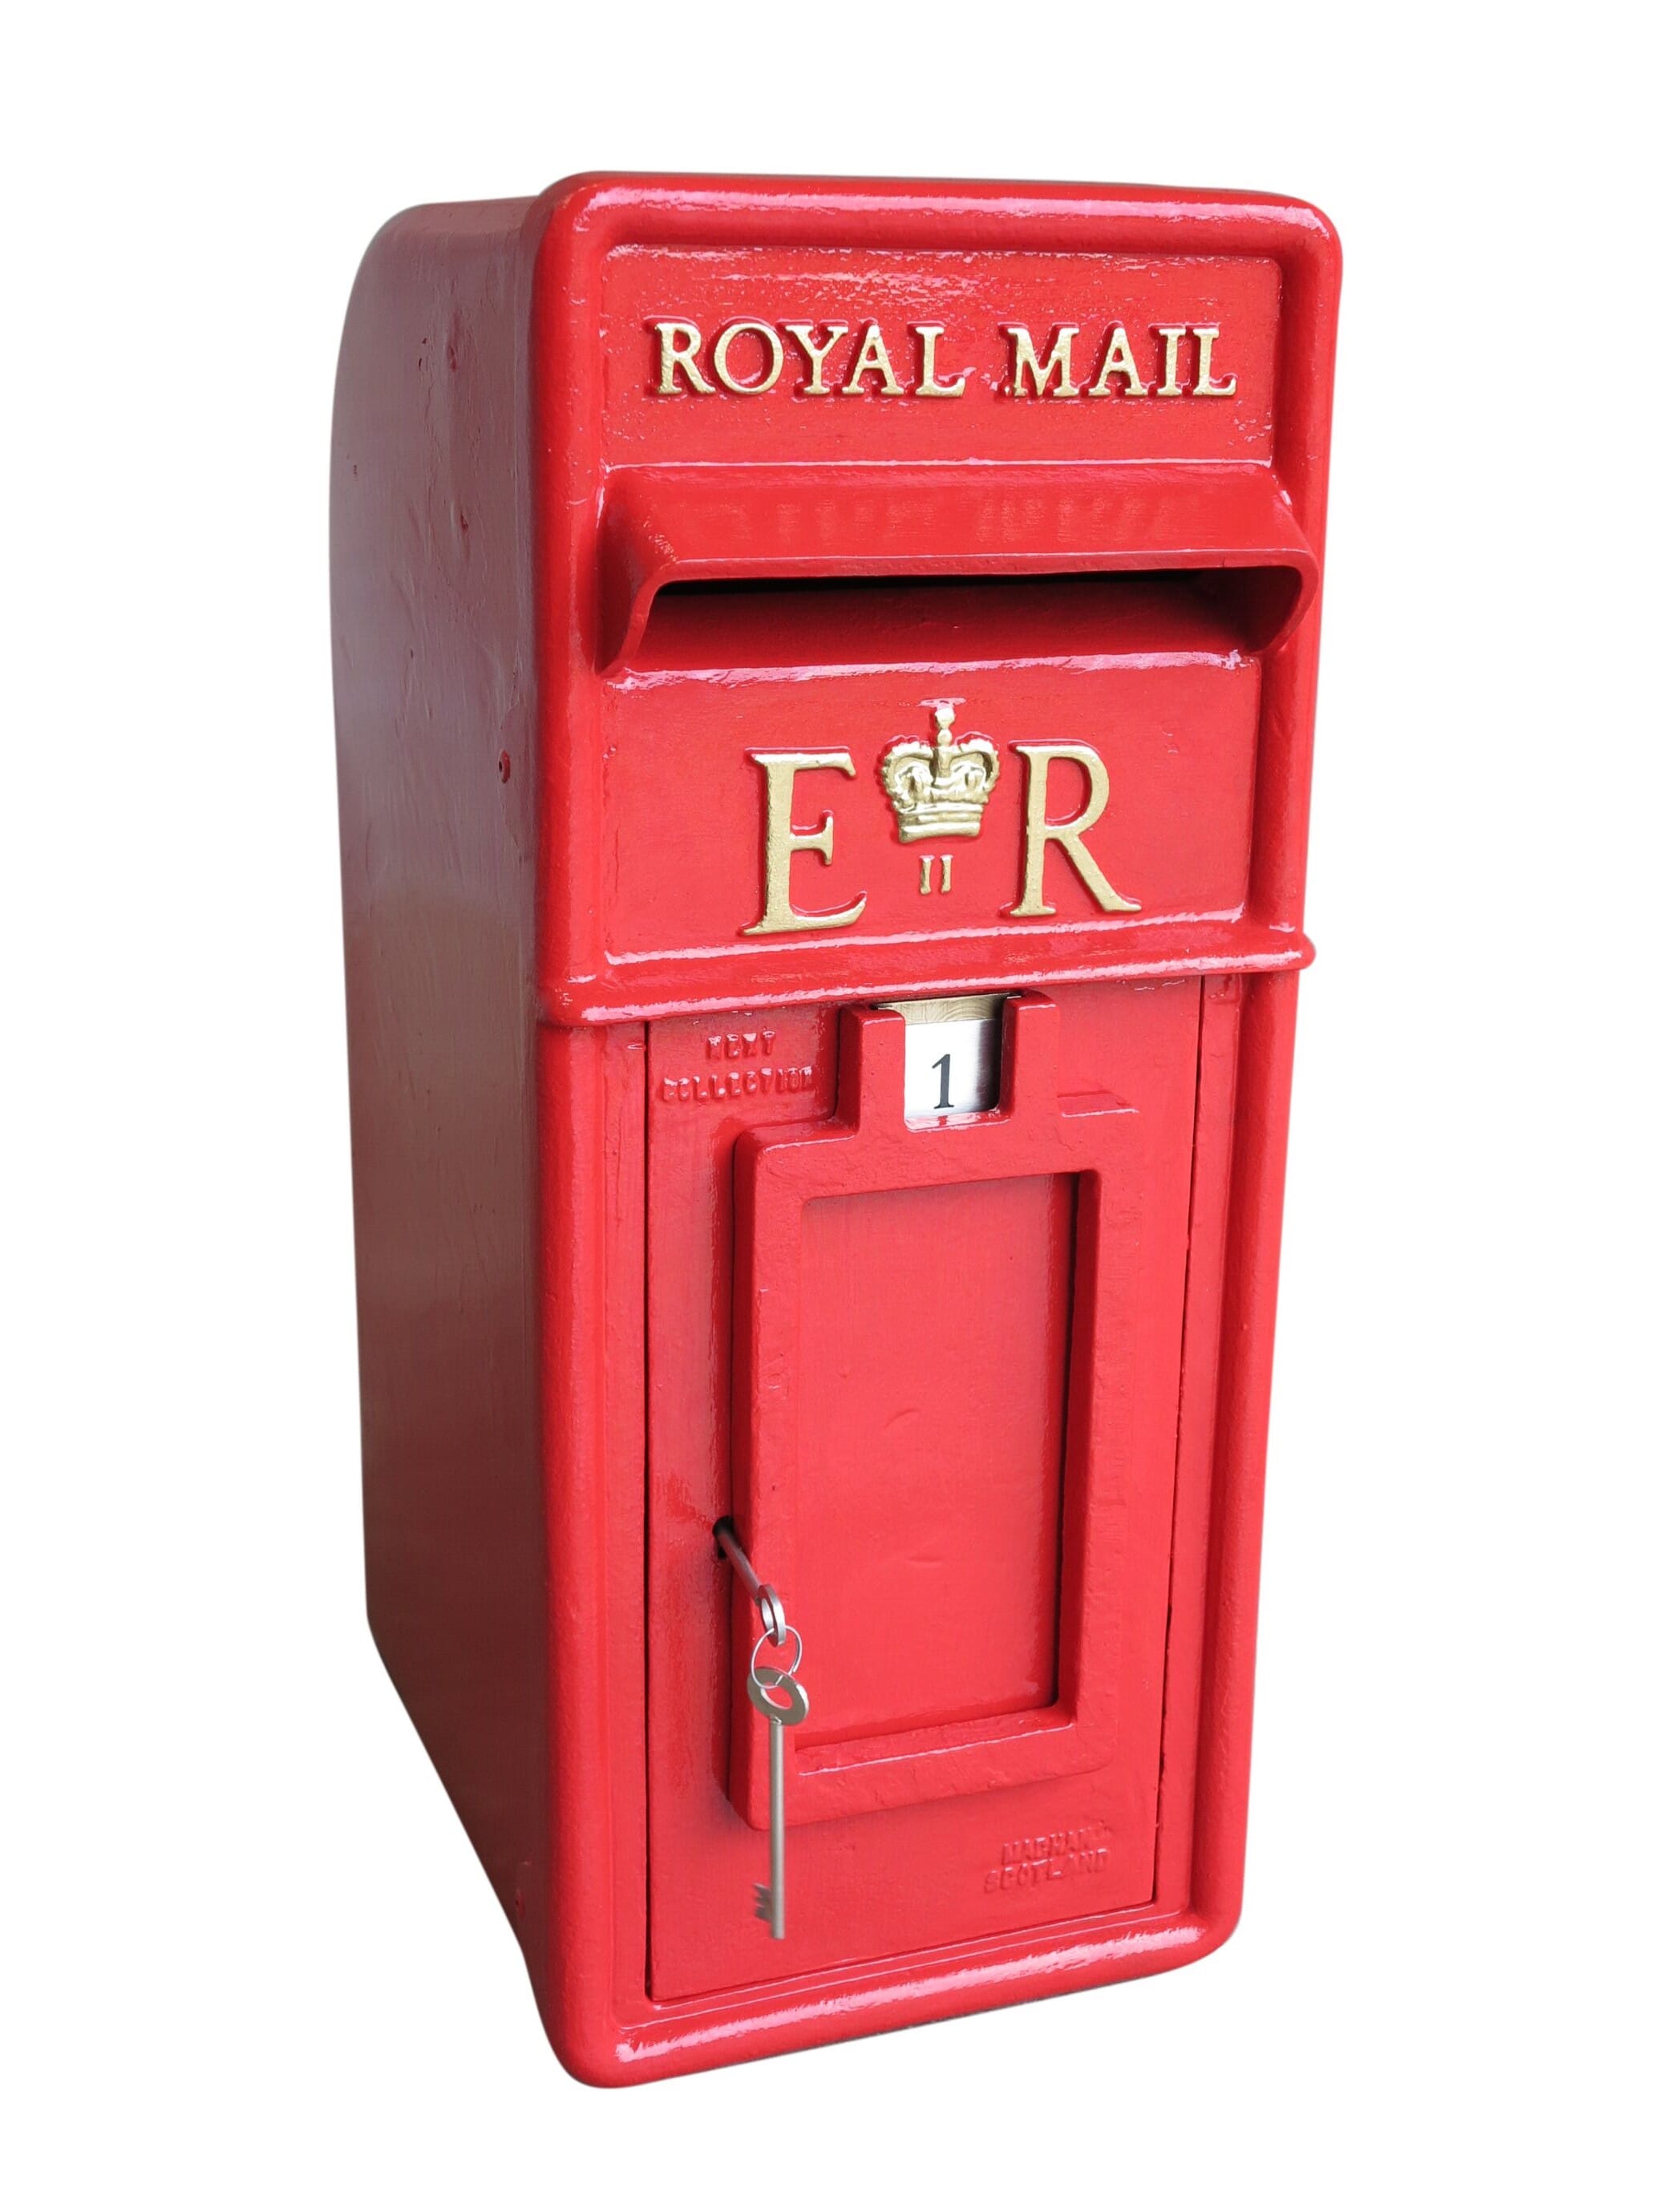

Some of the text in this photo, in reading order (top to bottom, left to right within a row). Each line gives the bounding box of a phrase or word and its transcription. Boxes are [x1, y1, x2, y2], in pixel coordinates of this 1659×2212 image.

[652, 321, 1237, 399] ROYAL MAIL
[741, 744, 1143, 936] E R
[706, 1029, 776, 1059] NEXT
[662, 1066, 813, 1102] COLLECTION
[931, 1053, 955, 1110] 1
